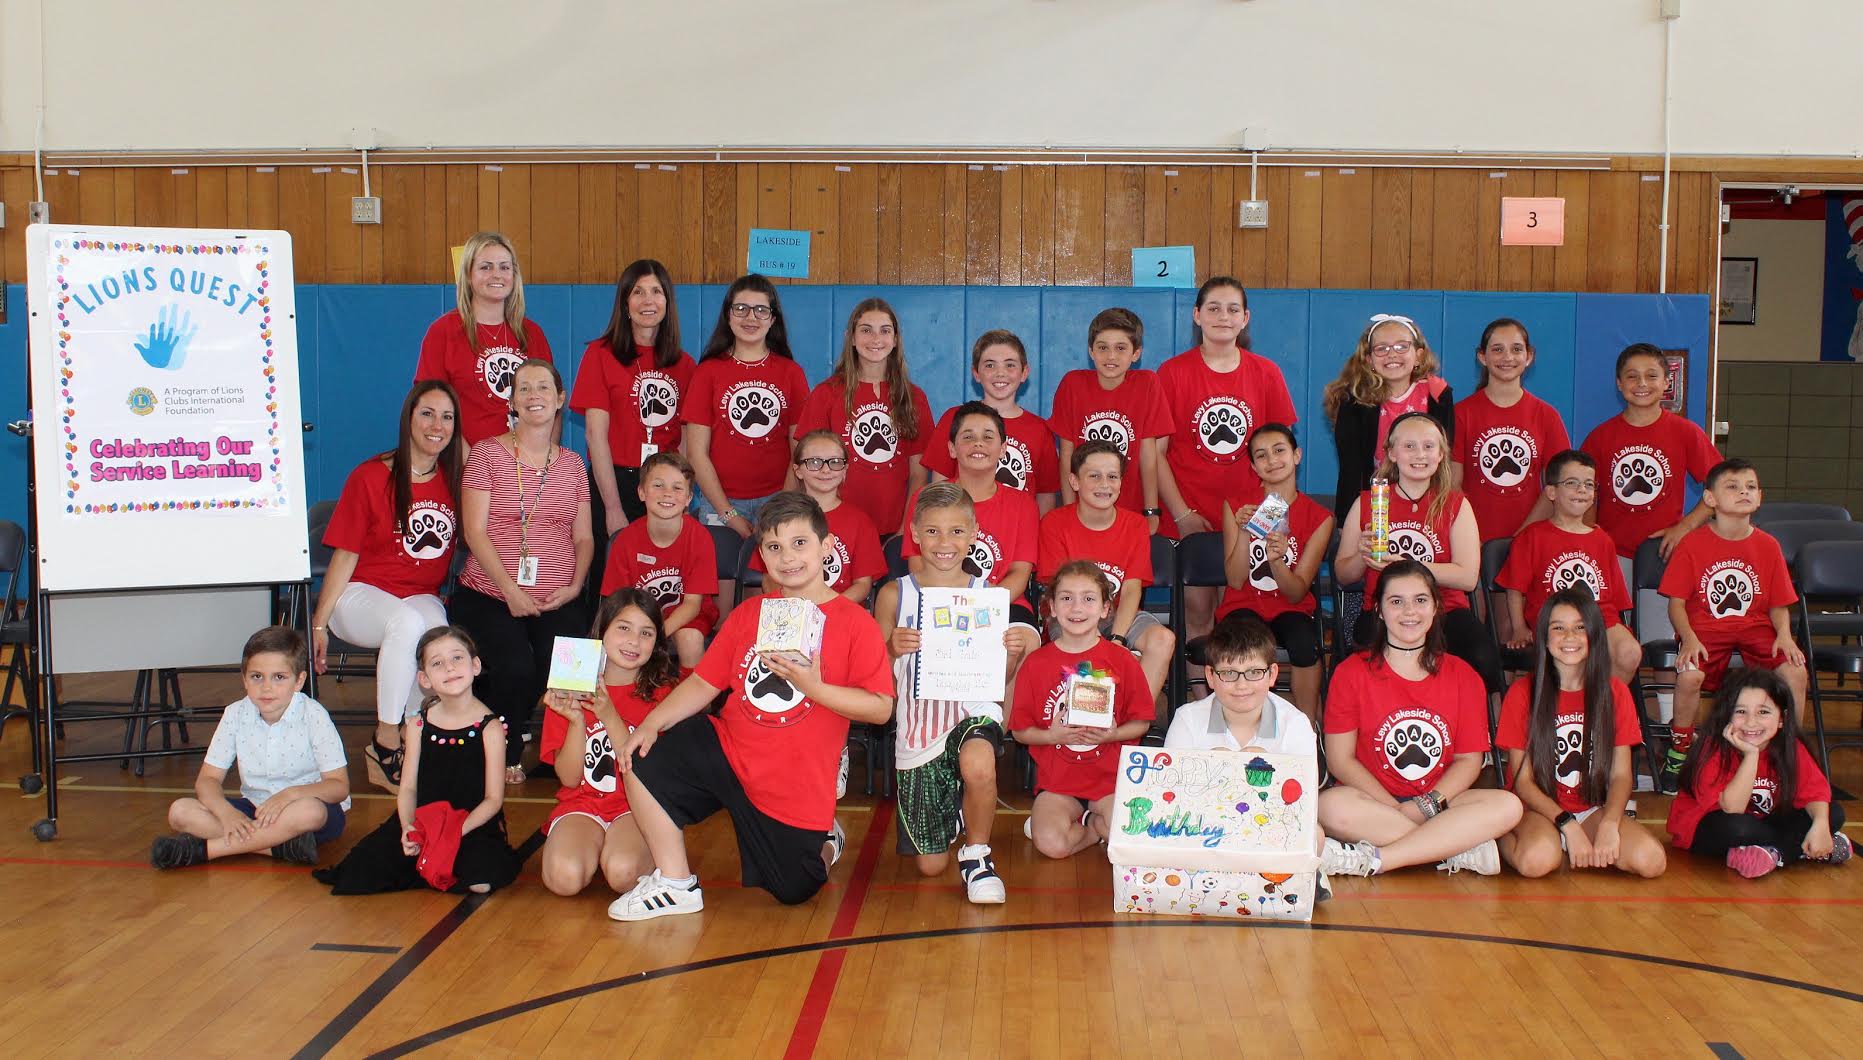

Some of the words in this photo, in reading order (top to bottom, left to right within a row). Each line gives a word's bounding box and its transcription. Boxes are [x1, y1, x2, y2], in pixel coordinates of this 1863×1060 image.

[1527, 211, 1538, 228] 3
[756, 236, 801, 246] LAKESIDE
[759, 260, 777, 269] BUS
[787, 261, 796, 270] 19
[1157, 260, 1169, 277] 2
[72, 266, 158, 315] LIONS
[169, 267, 258, 315] QUEST
[489, 360, 520, 380] ROAR
[164, 388, 171, 396] A
[172, 387, 209, 398] Program
[211, 386, 220, 396] of
[221, 387, 244, 395] Lions
[630, 375, 642, 397] Levy
[664, 374, 680, 400] School
[719, 390, 733, 410] Levy
[729, 379, 767, 391] Lakeside
[768, 383, 788, 409] School
[164, 397, 189, 406] Clubs
[190, 395, 245, 405] International
[165, 406, 215, 416] Foundation
[732, 394, 778, 418] ROARS
[851, 400, 888, 418] Lakeside
[1192, 405, 1206, 424] Levy
[1203, 396, 1238, 407] Lakeside
[1238, 401, 1253, 427] School
[854, 418, 896, 445] ROARS
[1085, 410, 1120, 423] Lakeside
[1120, 414, 1136, 442] School
[1202, 411, 1247, 435] ROARS
[90, 436, 211, 461] Celebrating
[216, 435, 254, 456] Our
[1091, 427, 1127, 451] OARS
[1472, 437, 1485, 458] Levy
[1481, 425, 1520, 439] Lakeside
[1520, 430, 1538, 458] School
[1020, 443, 1034, 473] School
[1483, 442, 1529, 466] ROARS
[1614, 444, 1653, 459] Lakeside
[1653, 449, 1672, 477] School
[90, 461, 167, 483] Service
[171, 458, 262, 483] Learning
[1616, 461, 1662, 485] ROARS
[833, 536, 851, 565] School
[985, 534, 1003, 561] School
[1389, 539, 1432, 562] OARS
[1422, 525, 1444, 554] School
[640, 567, 680, 583] Lakeside
[1542, 563, 1556, 584] Levy
[1552, 550, 1590, 565] Lakeside
[1590, 559, 1608, 590] School
[1557, 565, 1599, 593] ROARS
[1698, 573, 1710, 594] Levy
[1705, 558, 1745, 576] Lakeside
[1744, 564, 1762, 595] School
[1711, 577, 1751, 602] ROARS
[958, 637, 973, 647] of
[1043, 696, 1056, 720] Levy
[1374, 720, 1391, 742] Levy
[1388, 708, 1432, 724] Lakeside
[1431, 714, 1451, 747] School
[1386, 728, 1440, 756] ROARS
[1121, 797, 1226, 848] Birthday
